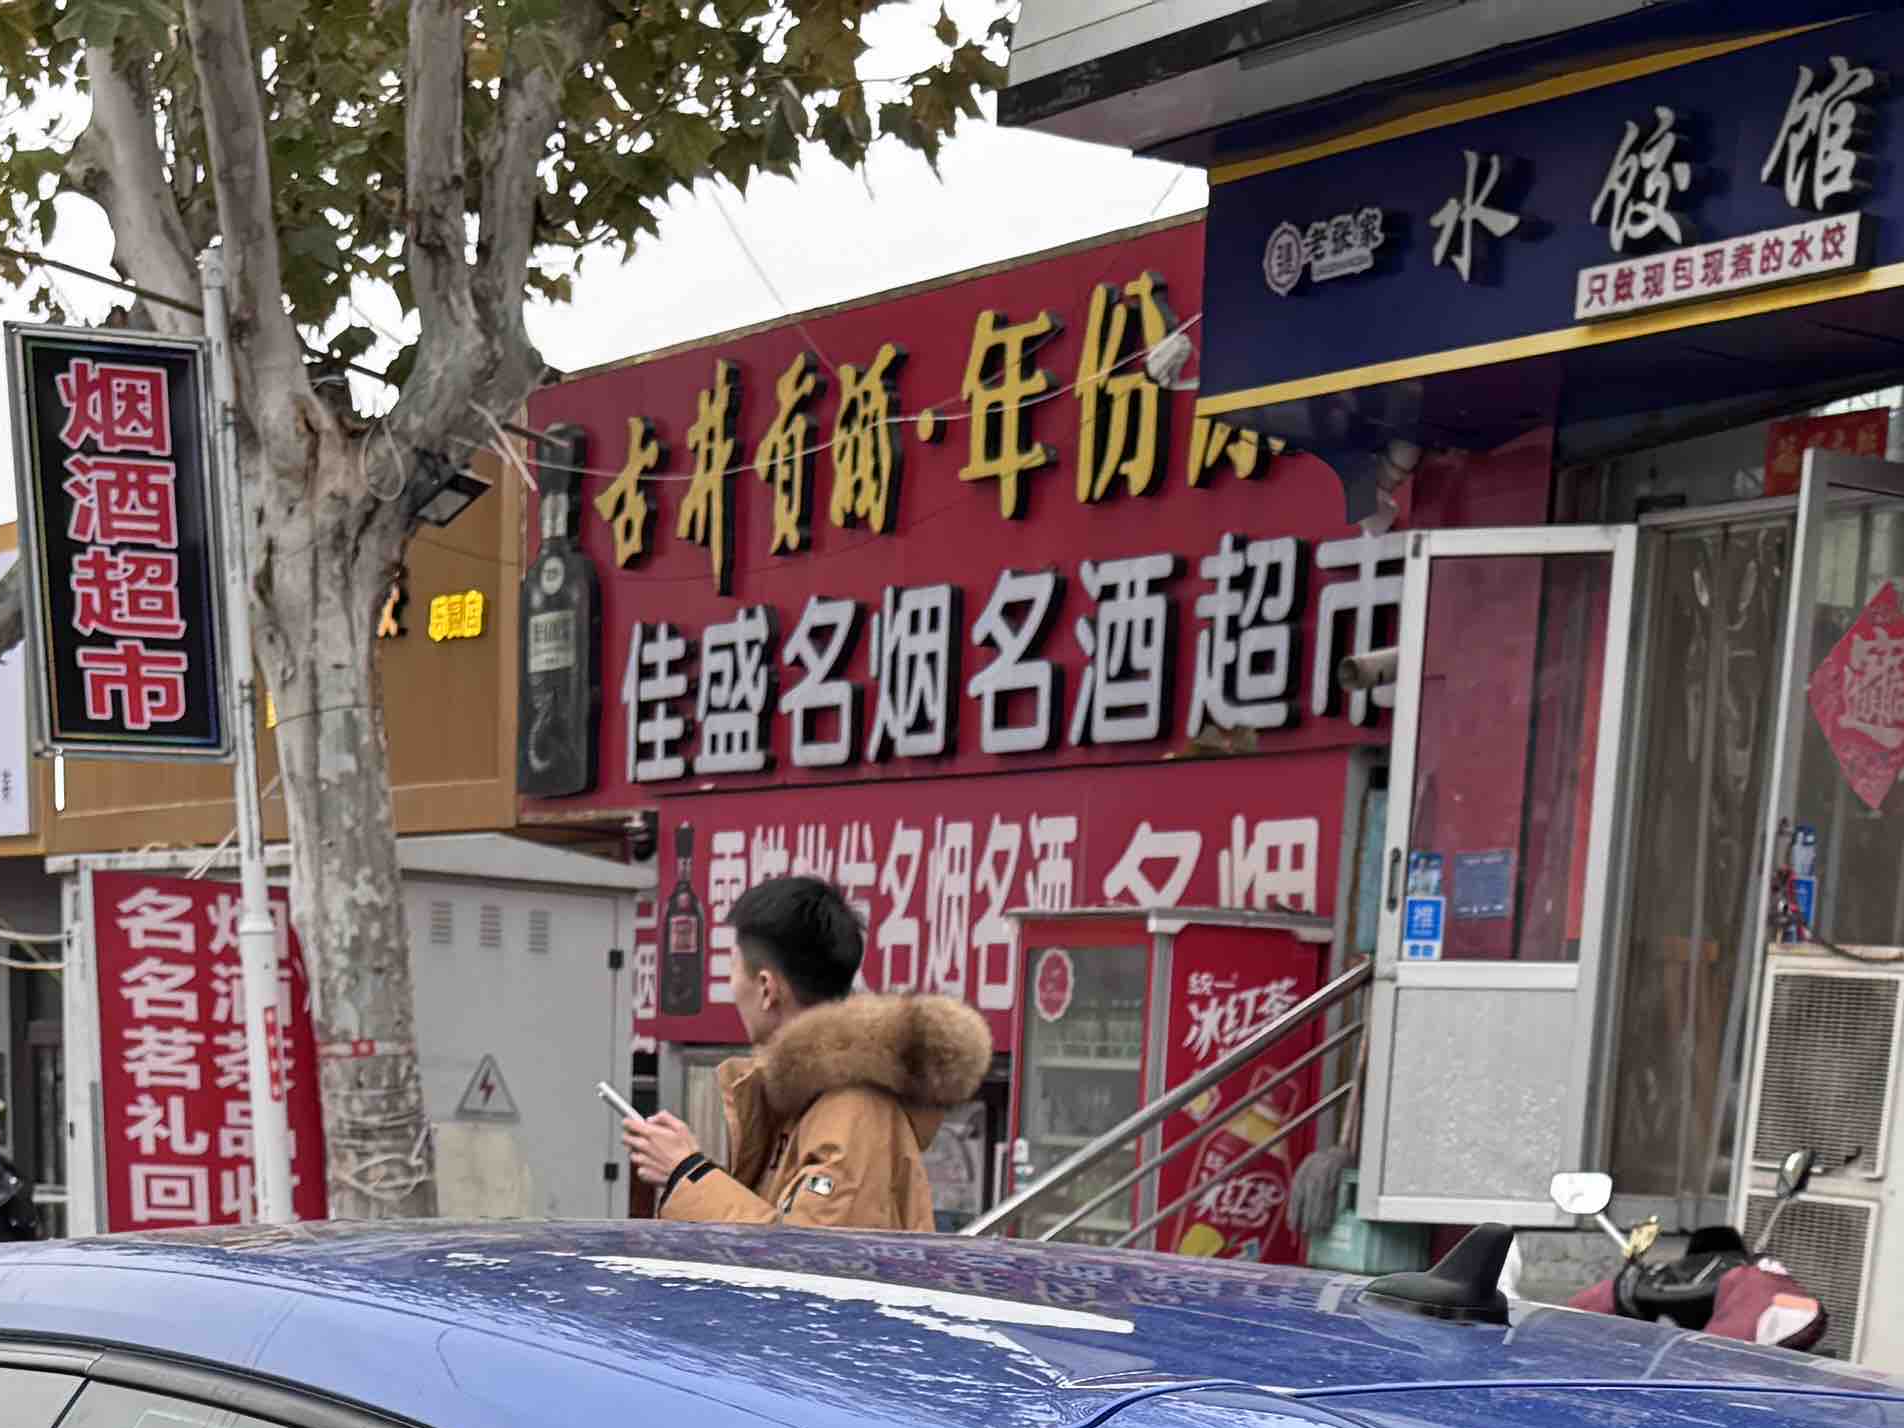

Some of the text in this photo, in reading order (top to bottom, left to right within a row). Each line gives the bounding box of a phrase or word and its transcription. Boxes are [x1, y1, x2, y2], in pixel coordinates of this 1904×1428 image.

[1304, 208, 1384, 262] 老张家
[1430, 56, 1875, 282] 水饺馆
[1585, 221, 1847, 308] 只做现包现煮的水饺
[56, 358, 187, 729] 烟酒超市
[622, 531, 1406, 783] 佳盛名烟名酒超市
